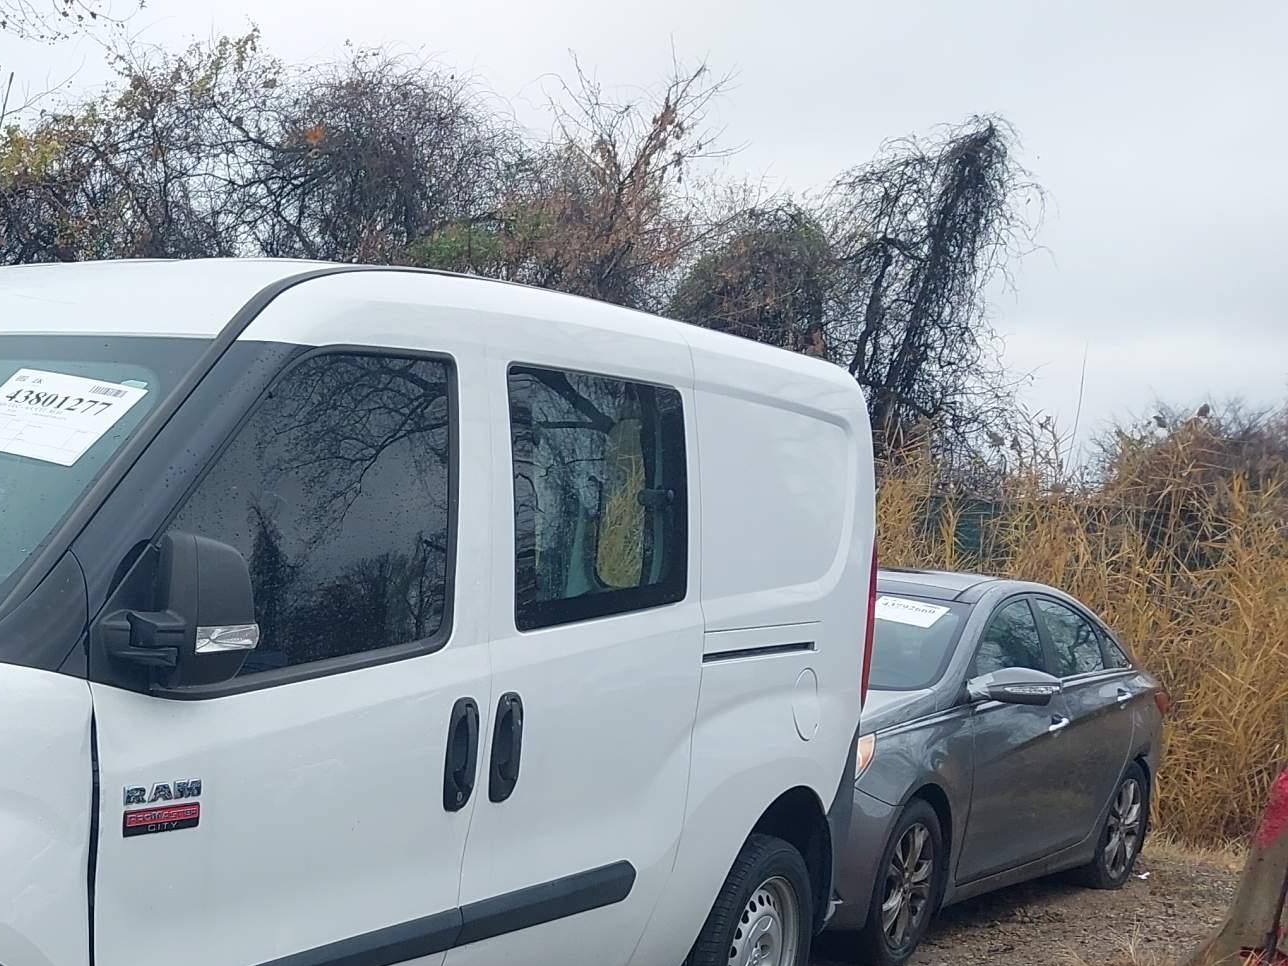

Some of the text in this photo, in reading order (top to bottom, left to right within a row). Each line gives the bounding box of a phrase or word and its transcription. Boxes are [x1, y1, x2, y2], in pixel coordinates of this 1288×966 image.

[5, 388, 114, 416] 43801277
[122, 778, 202, 806] RAM
[147, 820, 178, 832] CITY
